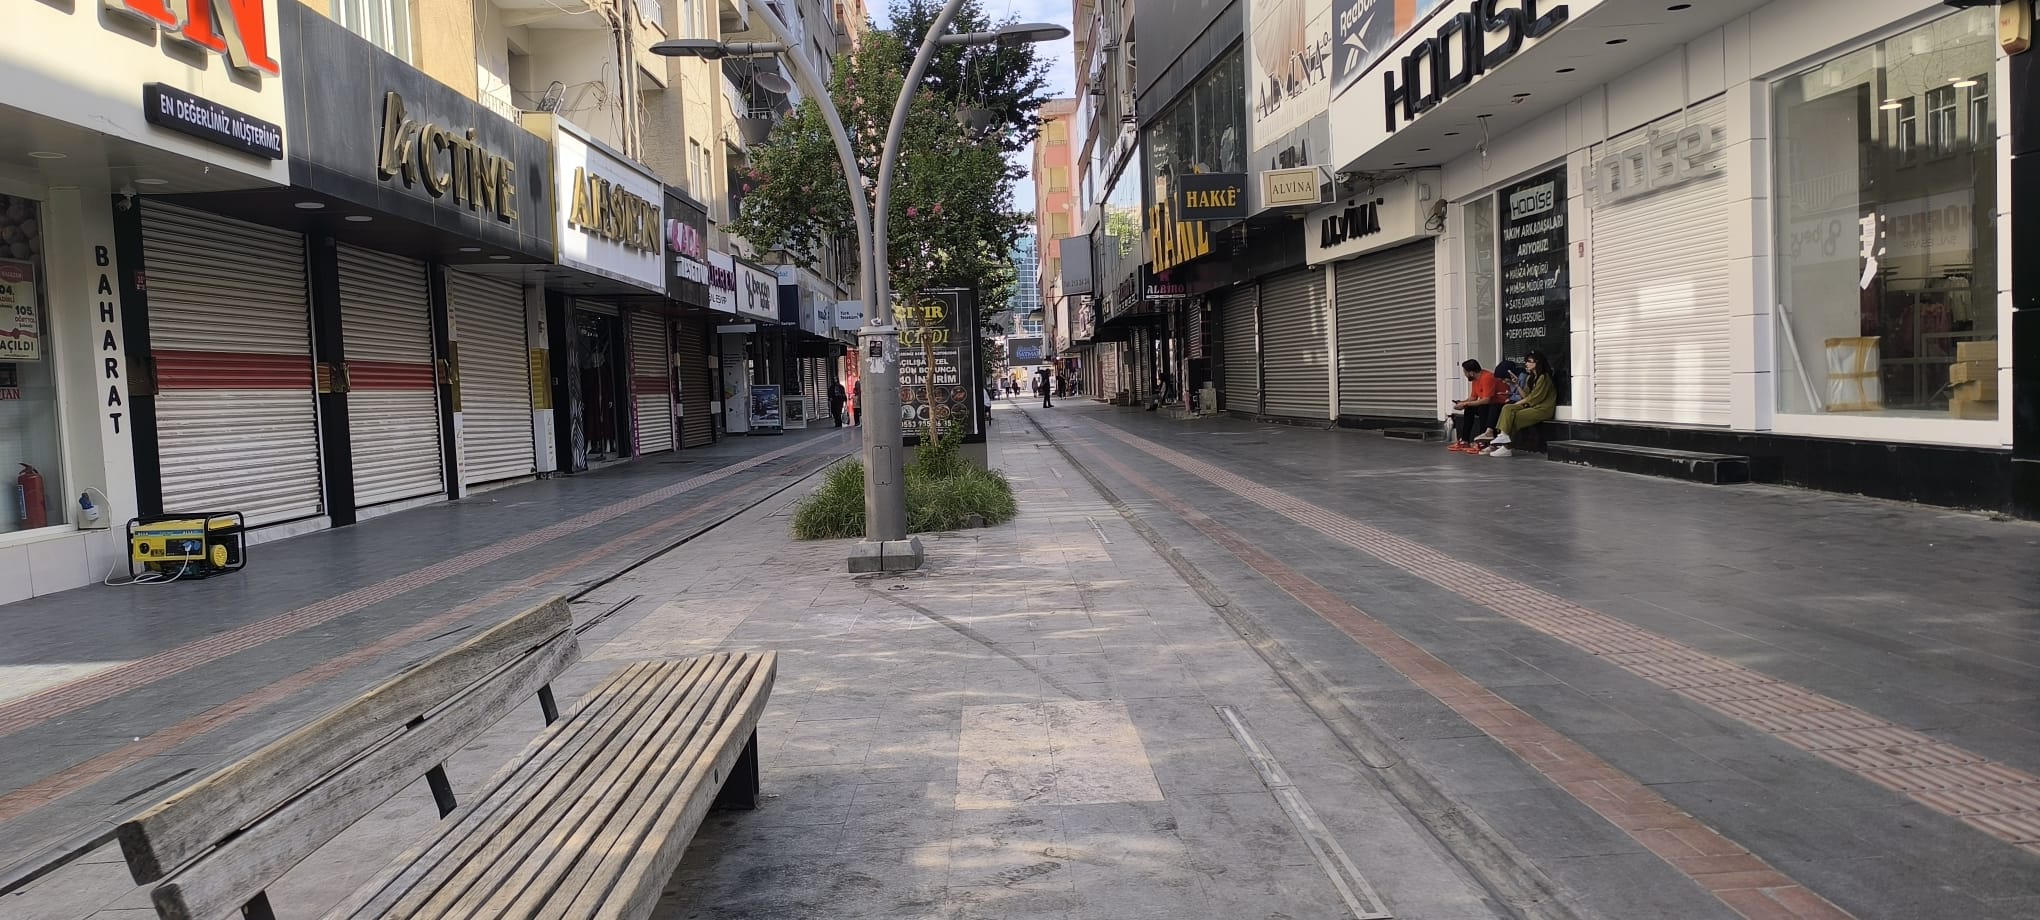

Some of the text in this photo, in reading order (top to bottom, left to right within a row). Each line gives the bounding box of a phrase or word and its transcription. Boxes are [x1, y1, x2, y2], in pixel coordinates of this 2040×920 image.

[1340, 0, 1378, 37] Reebo
[160, 94, 281, 152] EN DEĞERLİMİZ MÜŞTERİMİZ
[1272, 181, 1312, 195] ALVİNA
[1320, 199, 1381, 249] ALVİNA
[1504, 226, 1521, 241] TAKIM
[95, 245, 123, 434] BAHARAT
[1508, 328, 1522, 339] DEPO
[0, 340, 34, 353] AÇILDI
[919, 366, 957, 374] BOUNCA
[915, 373, 957, 384] İNİRİM
